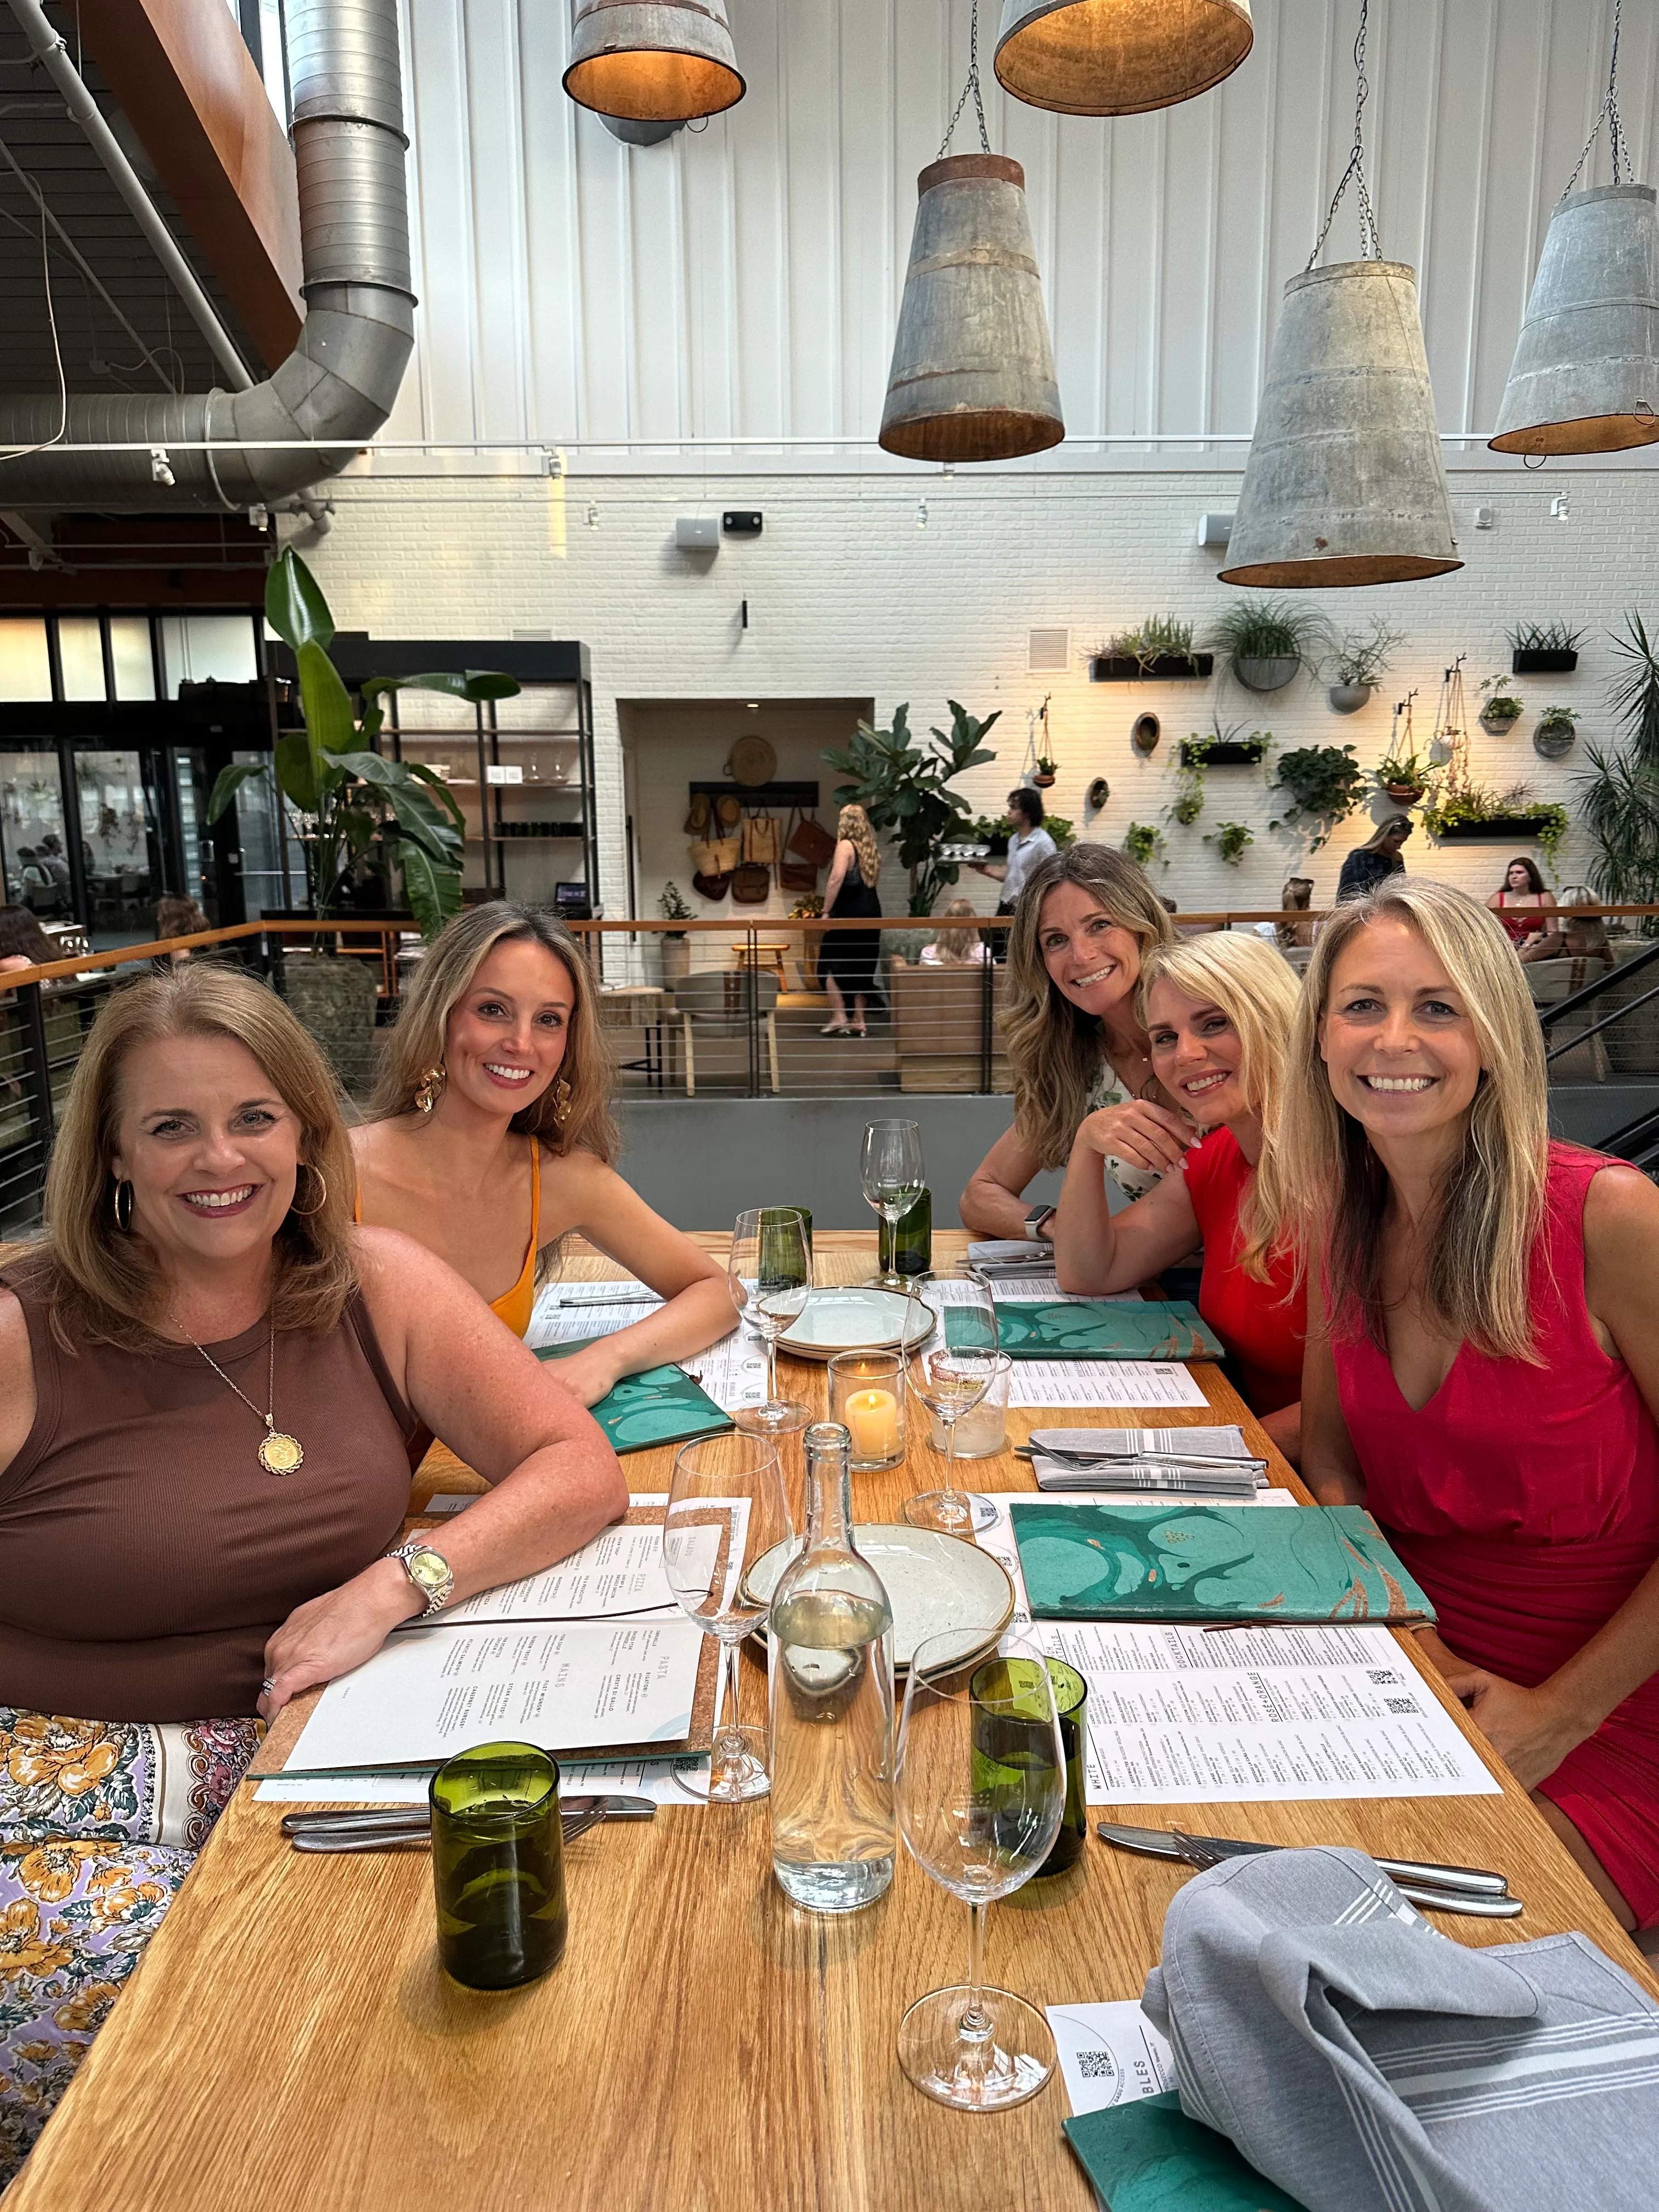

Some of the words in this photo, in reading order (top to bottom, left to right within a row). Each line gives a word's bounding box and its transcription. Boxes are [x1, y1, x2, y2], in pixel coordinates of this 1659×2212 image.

[633, 1573, 646, 1592] PIZZA
[1164, 1632, 1187, 1668] COCKTAILS
[555, 1663, 570, 1687] MAINS
[656, 1656, 669, 1679] PASTA
[505, 1683, 514, 1696] STEAK
[613, 1674, 621, 1689] CRESTE
[466, 1685, 478, 1707] CABERNET
[1247, 1672, 1279, 1722] ROSÉ+ORANGE
[1086, 1764, 1102, 1789] WHITE
[1133, 2061, 1154, 2094] BLES
